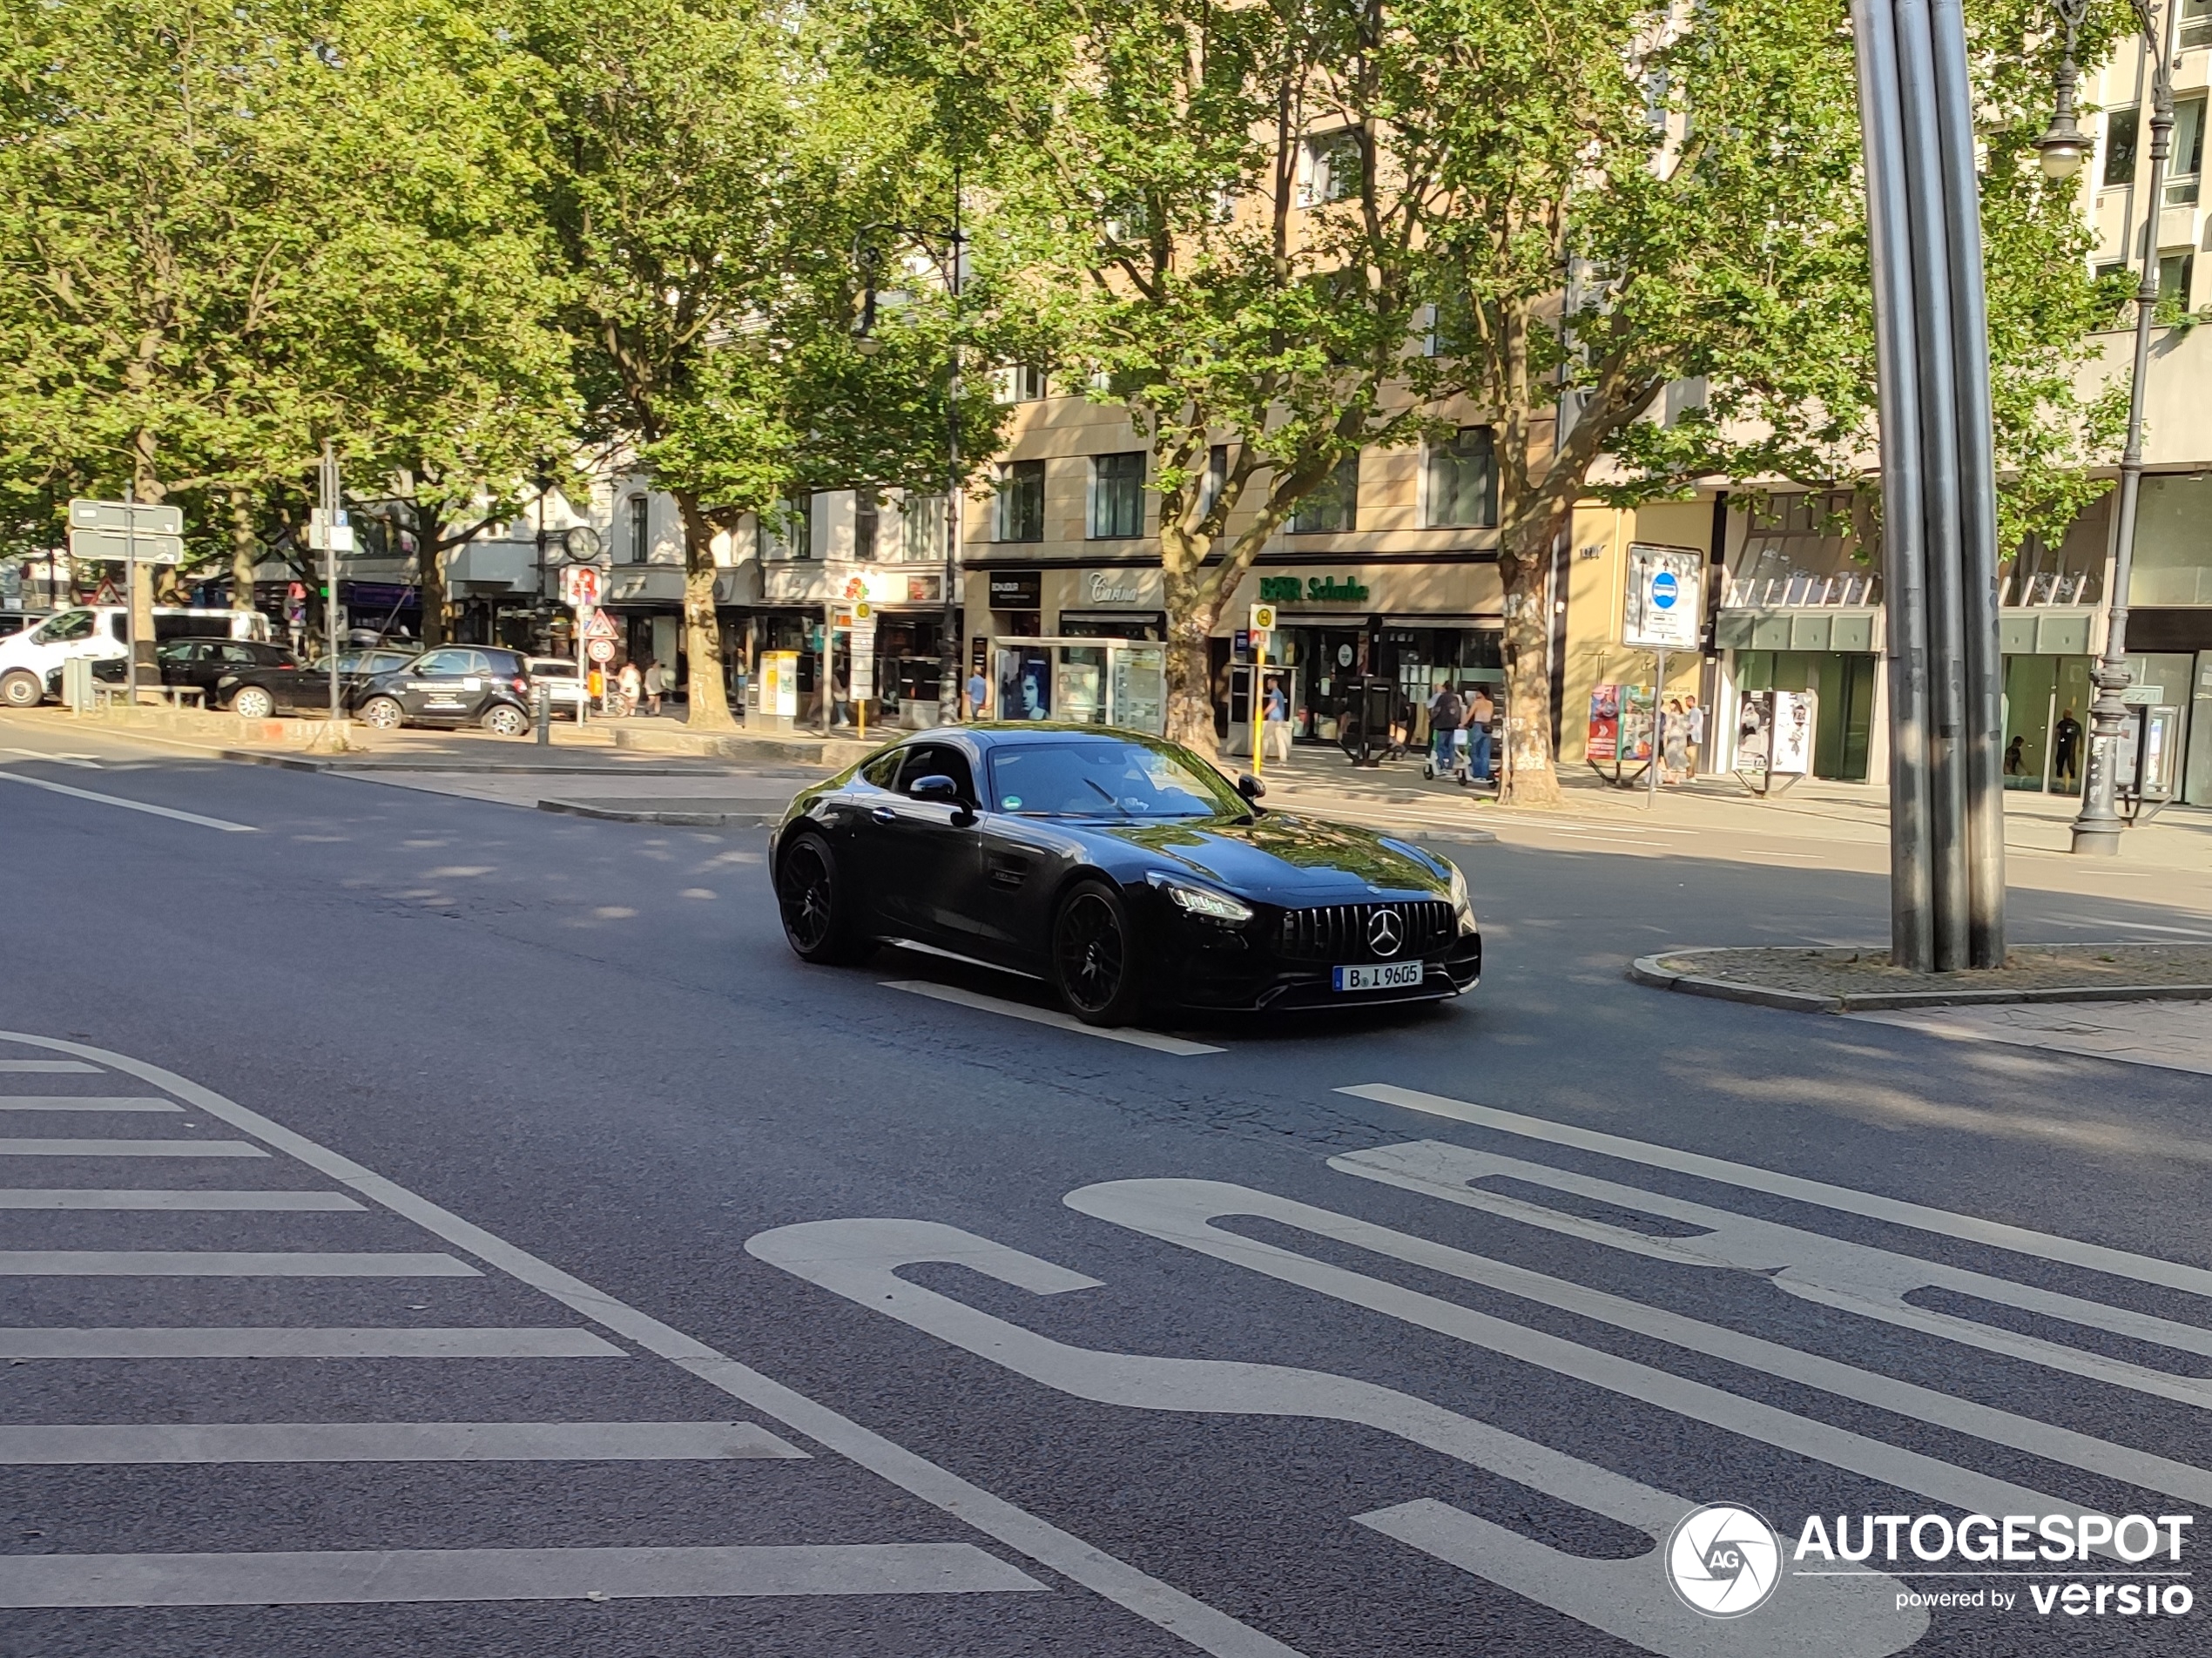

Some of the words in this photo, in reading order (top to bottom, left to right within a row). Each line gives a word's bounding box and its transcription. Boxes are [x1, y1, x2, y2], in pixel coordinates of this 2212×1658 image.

[1088, 572, 1138, 603] Carina
[1350, 969, 1360, 987] B
[1372, 968, 1380, 986] I
[1386, 965, 1417, 985] 9605
